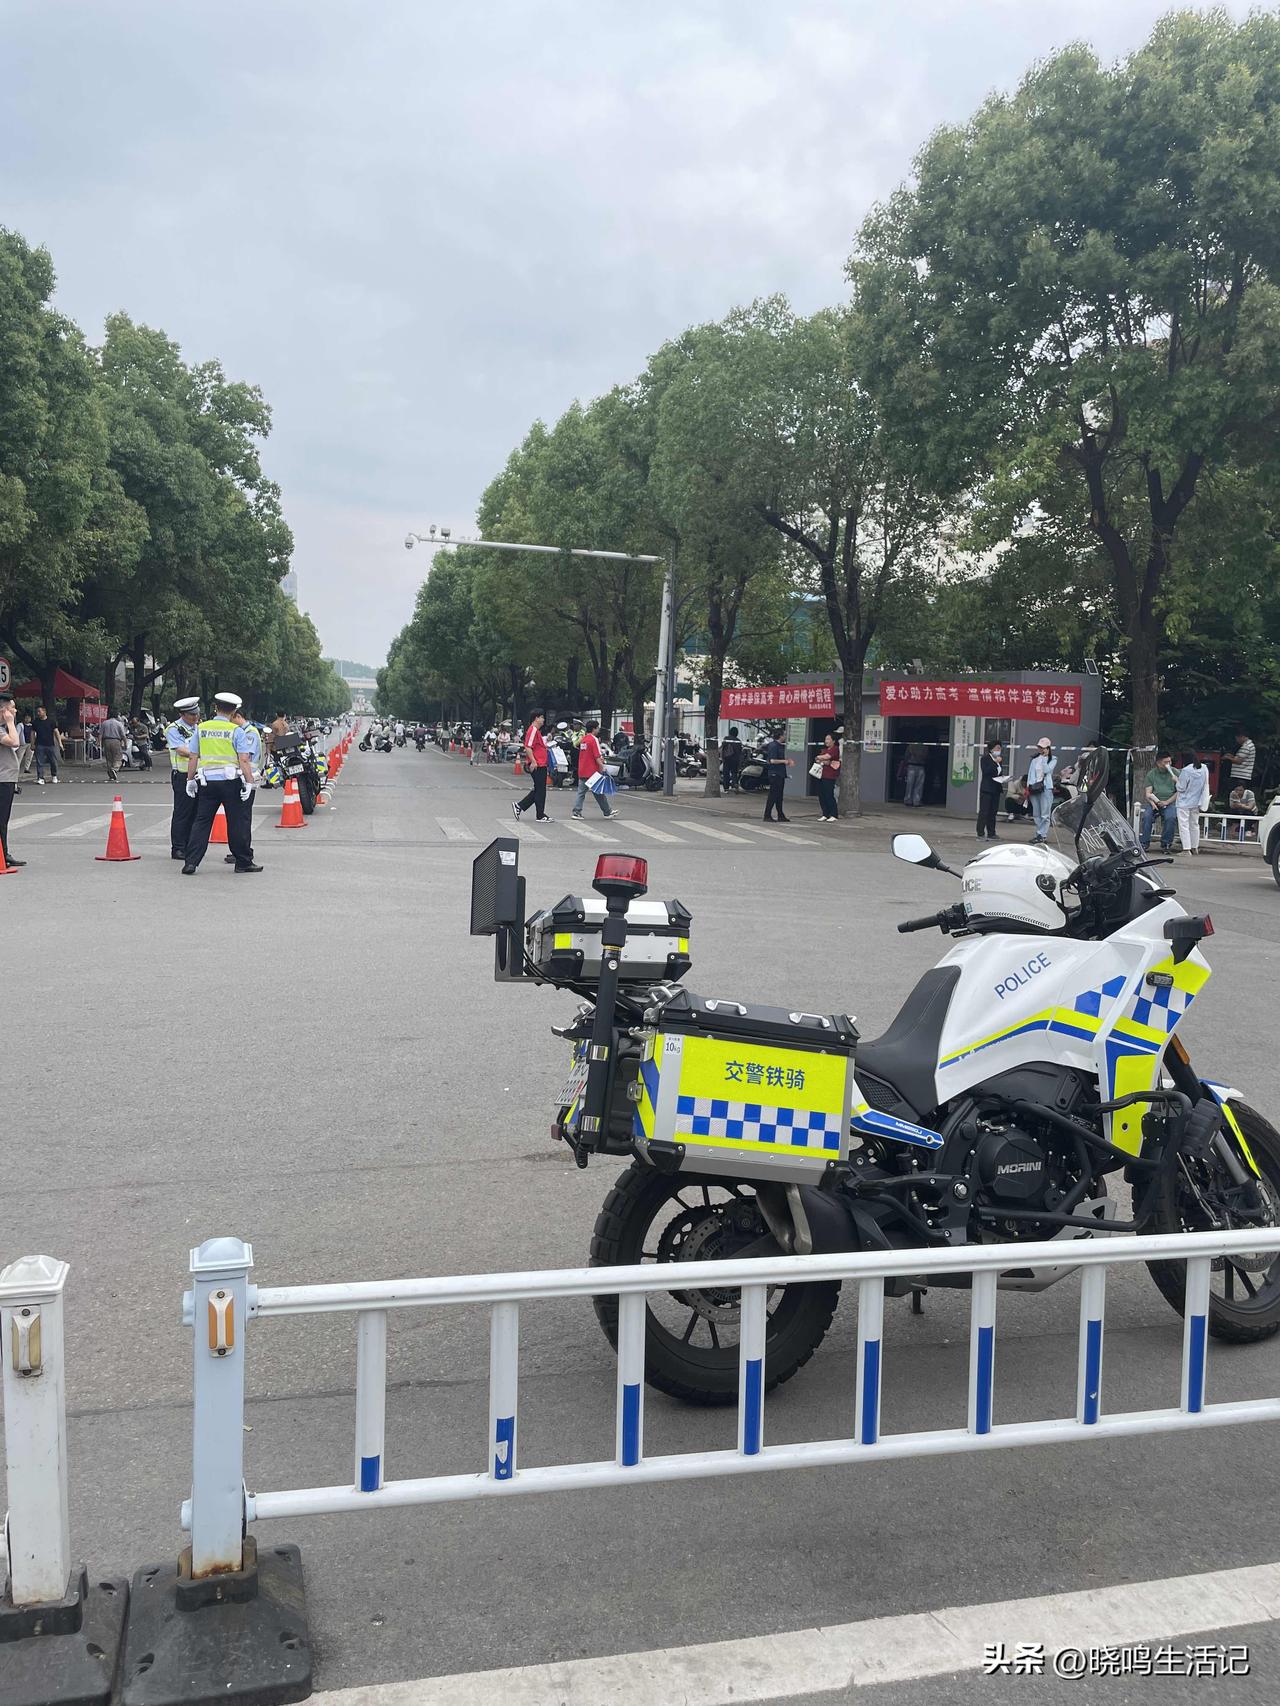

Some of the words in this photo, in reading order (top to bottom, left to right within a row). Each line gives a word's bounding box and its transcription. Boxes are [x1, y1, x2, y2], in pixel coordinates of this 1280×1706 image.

[885, 685, 959, 701] 爱心助力高考
[967, 687, 1075, 708] 温情相伴追梦少年
[994, 952, 1052, 1000] POLICE
[724, 1059, 806, 1091] 交警铁骑
[996, 1161, 1042, 1175] MORINI
